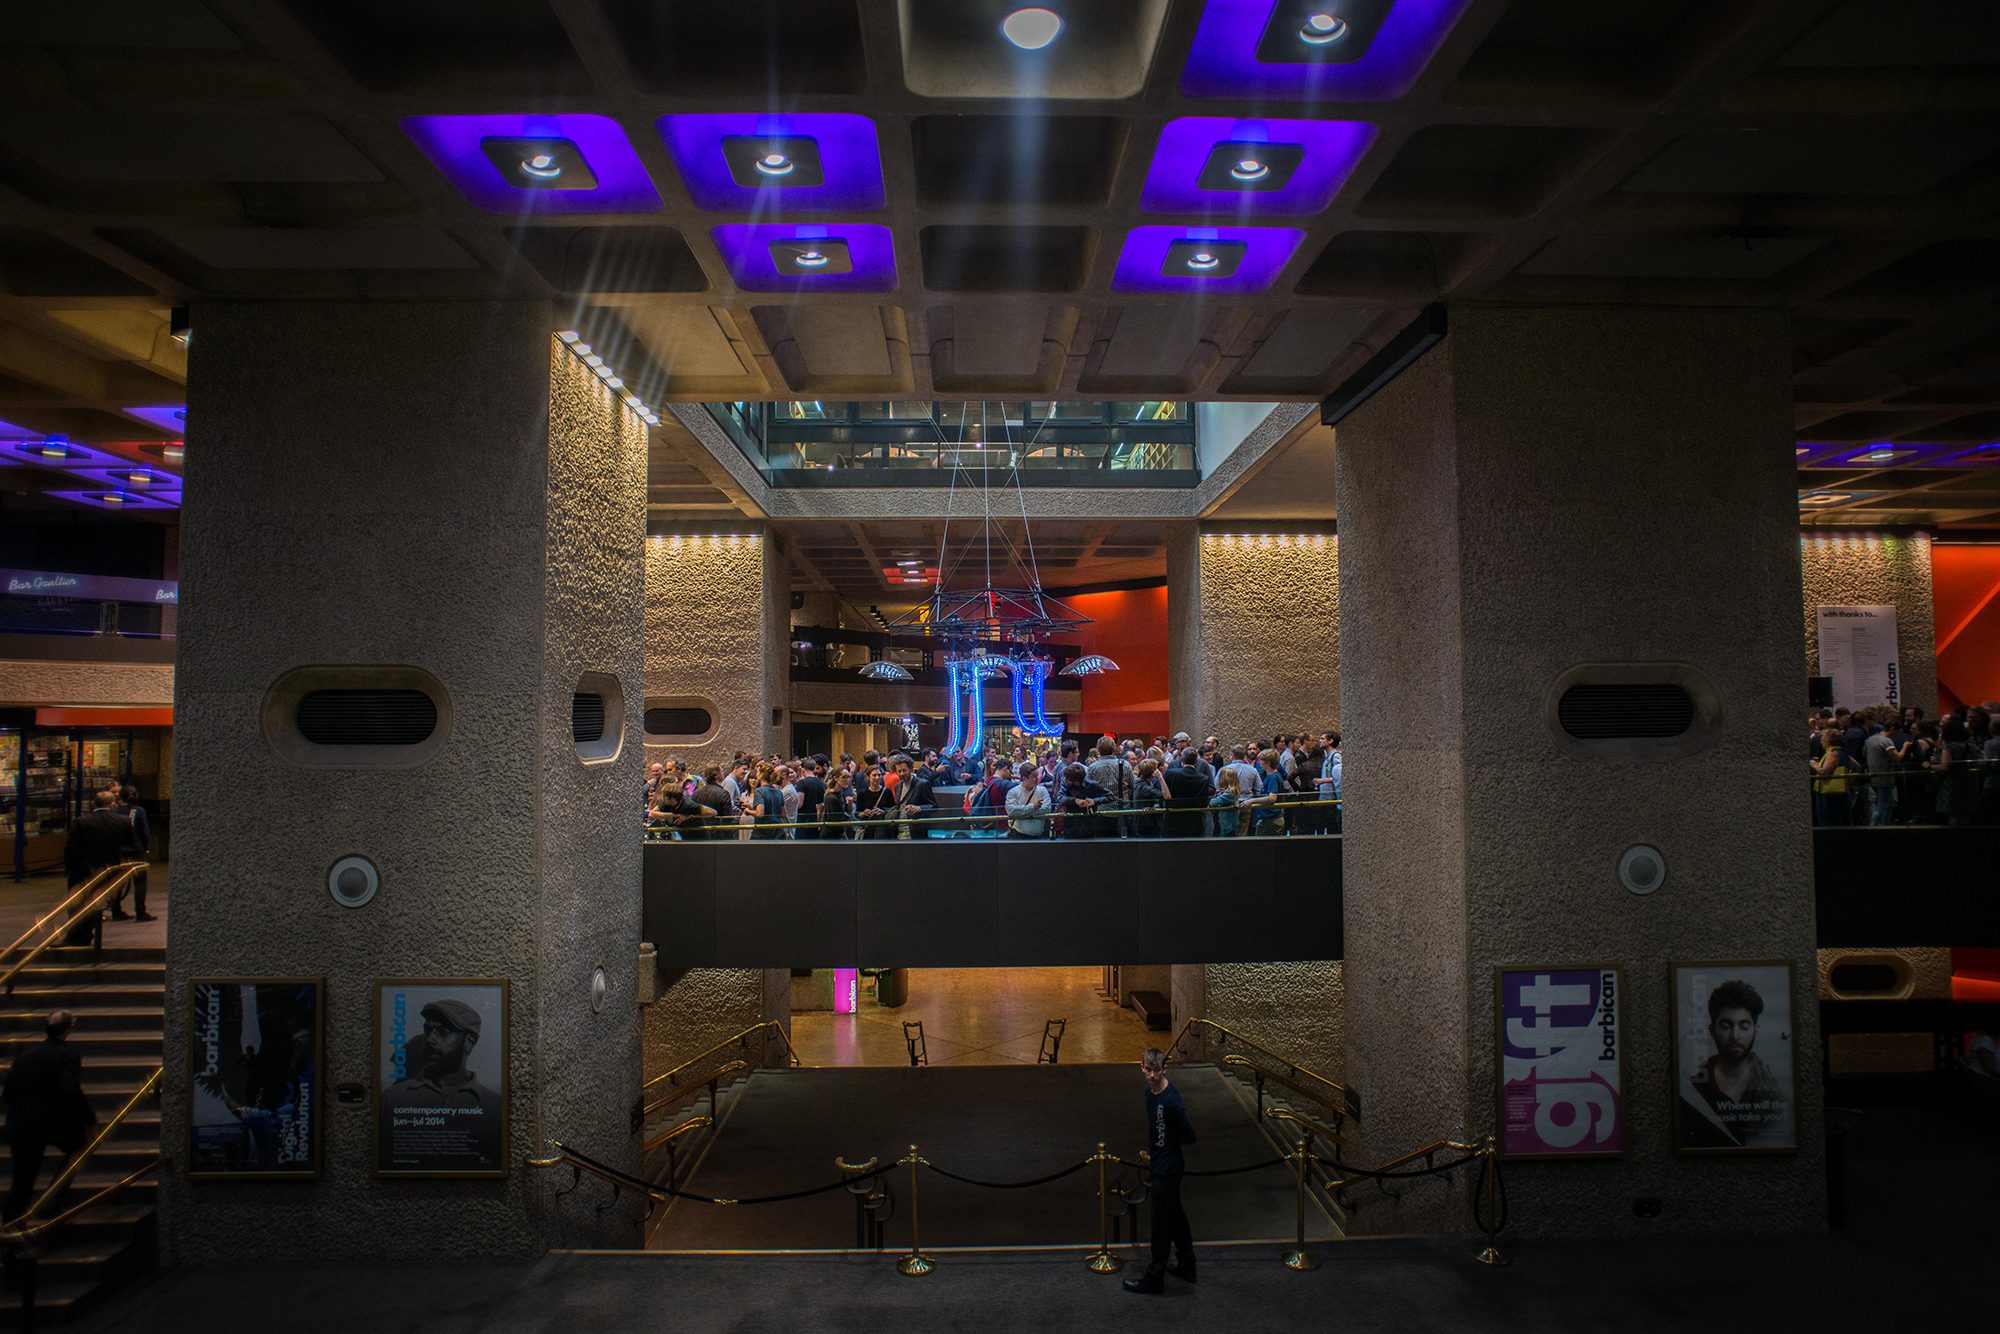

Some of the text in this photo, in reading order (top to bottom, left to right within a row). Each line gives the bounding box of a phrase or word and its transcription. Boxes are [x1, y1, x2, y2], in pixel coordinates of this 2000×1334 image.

[8, 579, 32, 591] Bar
[156, 589, 176, 601] Bar
[1885, 662, 1898, 708] rbican
[200, 989, 221, 1077] barbican
[389, 993, 408, 1079] barbican
[1598, 973, 1616, 1061] barbican
[296, 1082, 310, 1162] Revolution
[393, 1105, 484, 1116] contemporary music
[425, 1117, 445, 1126] 2014
[1154, 1104, 1166, 1148] barbican
[1716, 1100, 1788, 1110] Where will the
[1738, 1112, 1761, 1121] take
[1762, 1112, 1788, 1123] you?
[277, 1113, 298, 1164] Digital
